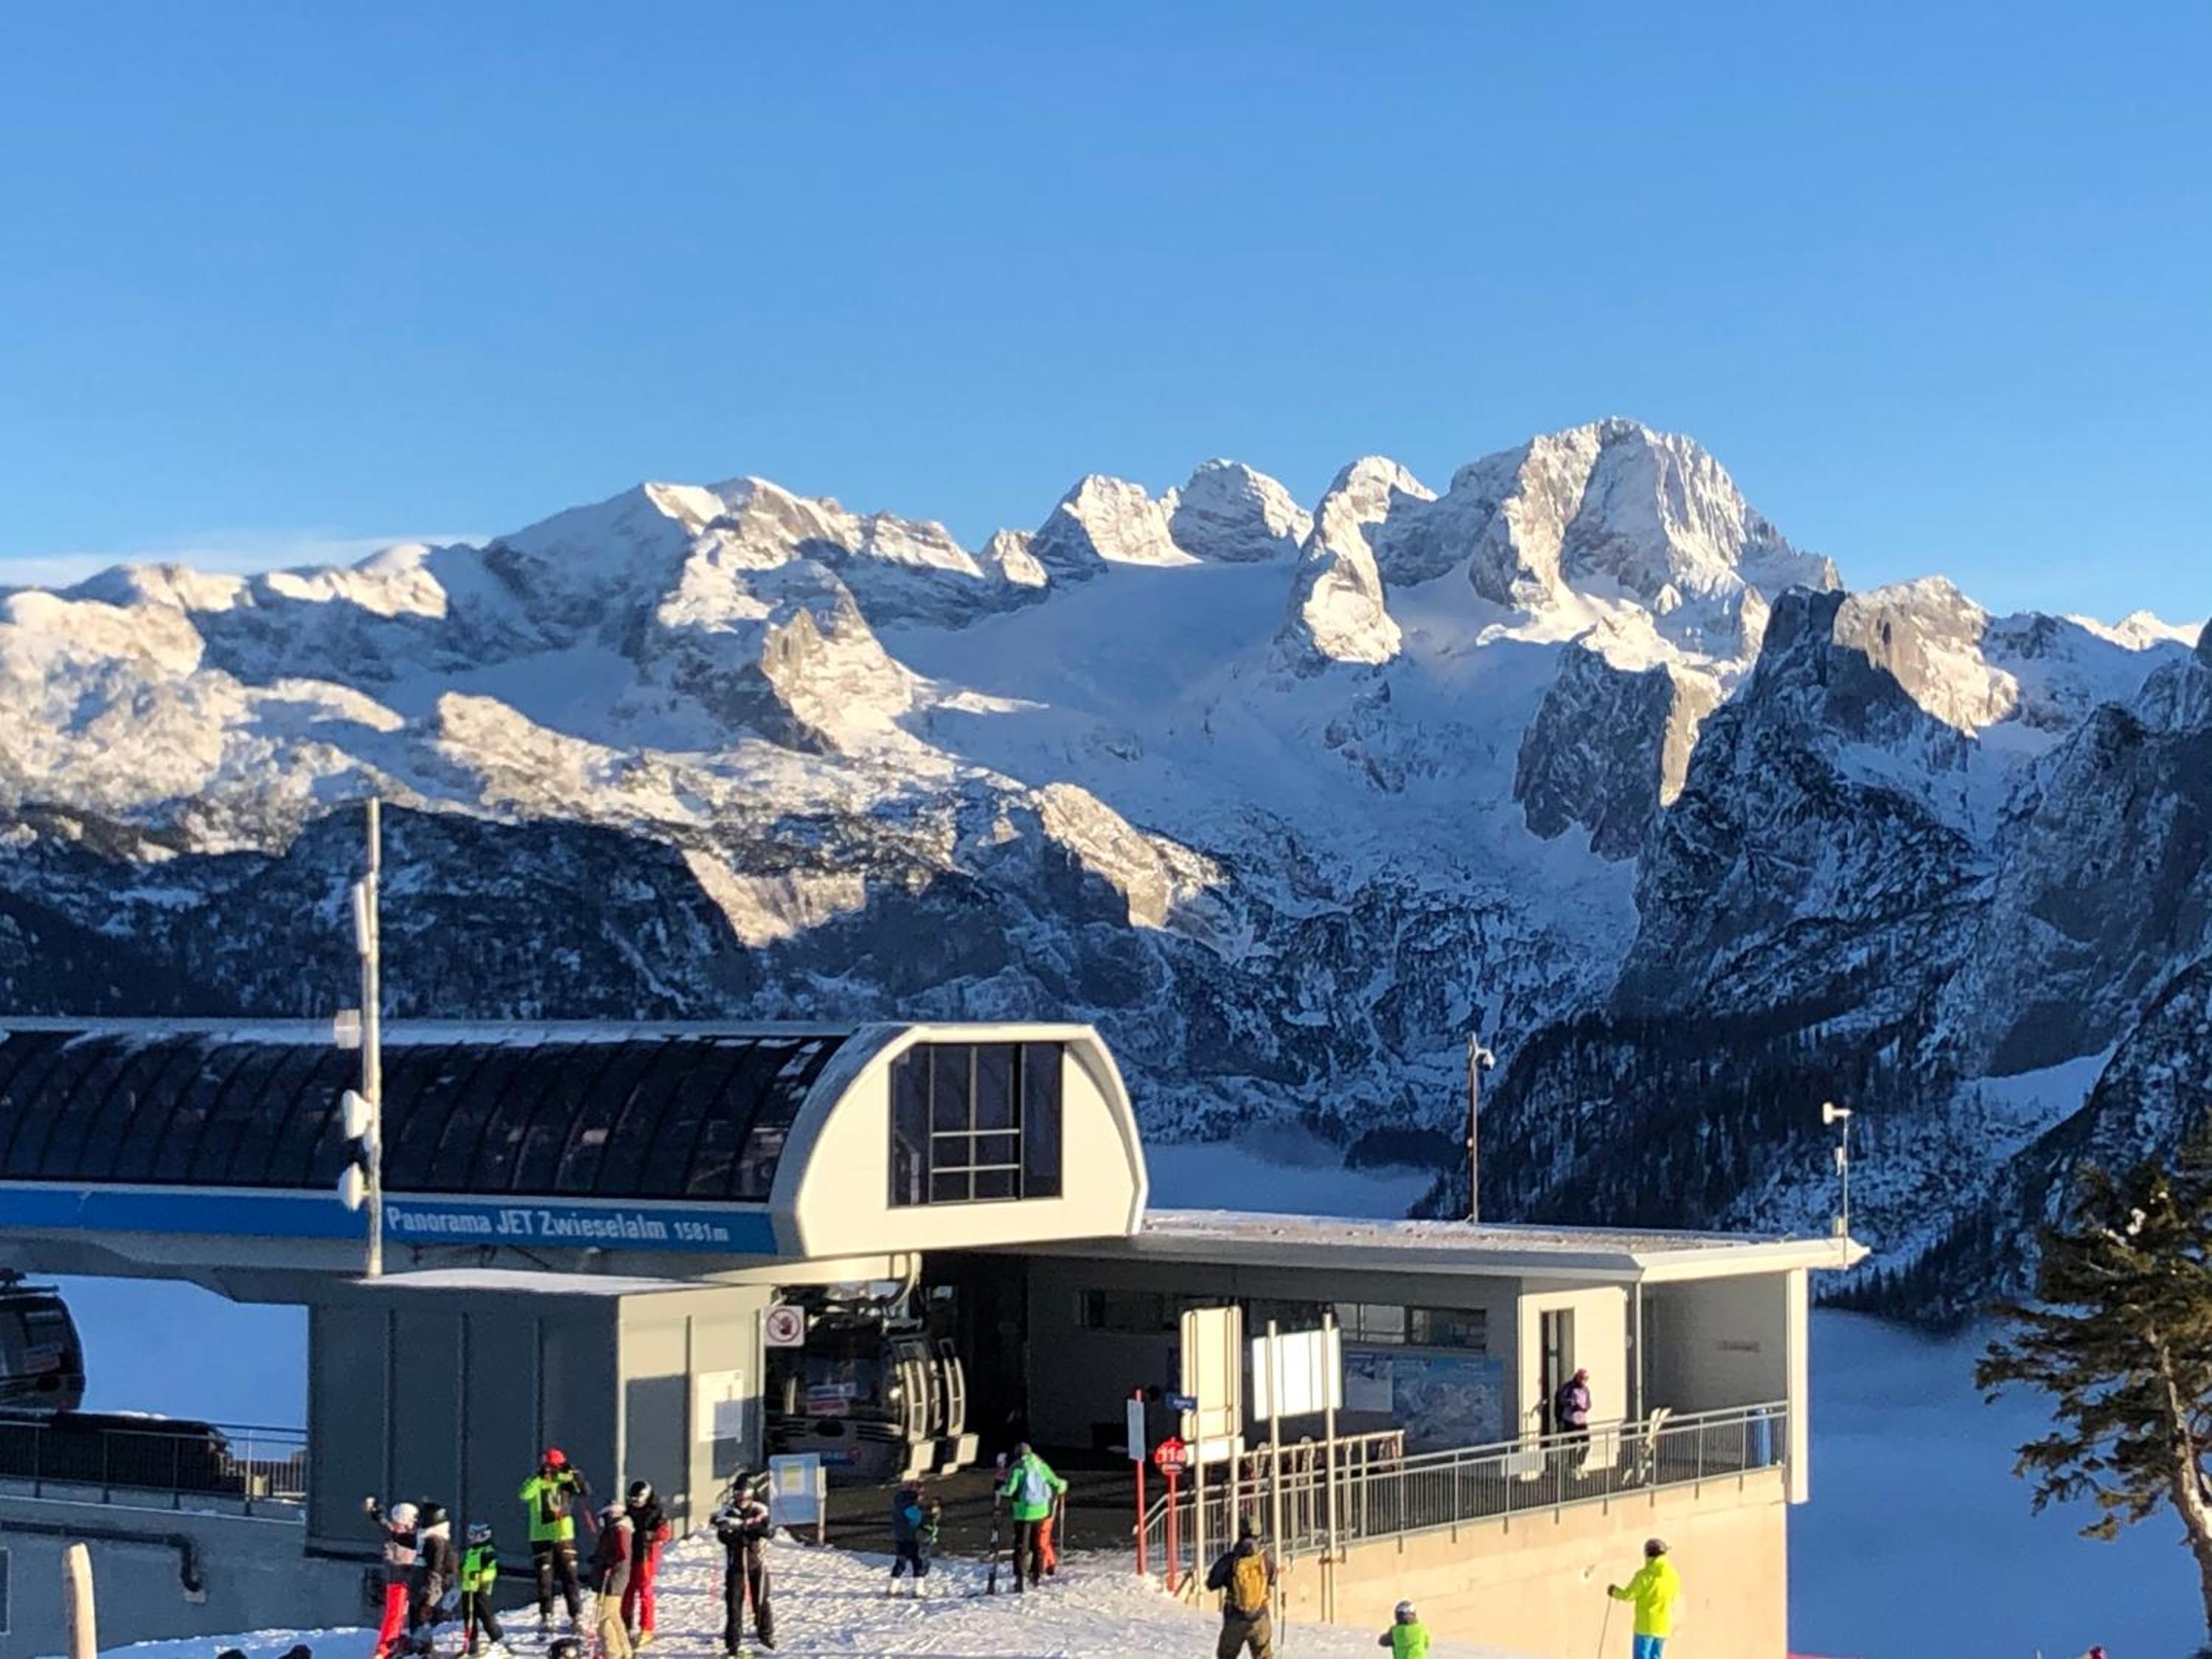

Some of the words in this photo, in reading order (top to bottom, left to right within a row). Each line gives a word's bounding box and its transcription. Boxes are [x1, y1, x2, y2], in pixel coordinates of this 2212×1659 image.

[386, 1206, 493, 1233] Panorama
[496, 1209, 533, 1235] JET
[538, 1211, 668, 1240] Zwieselalm
